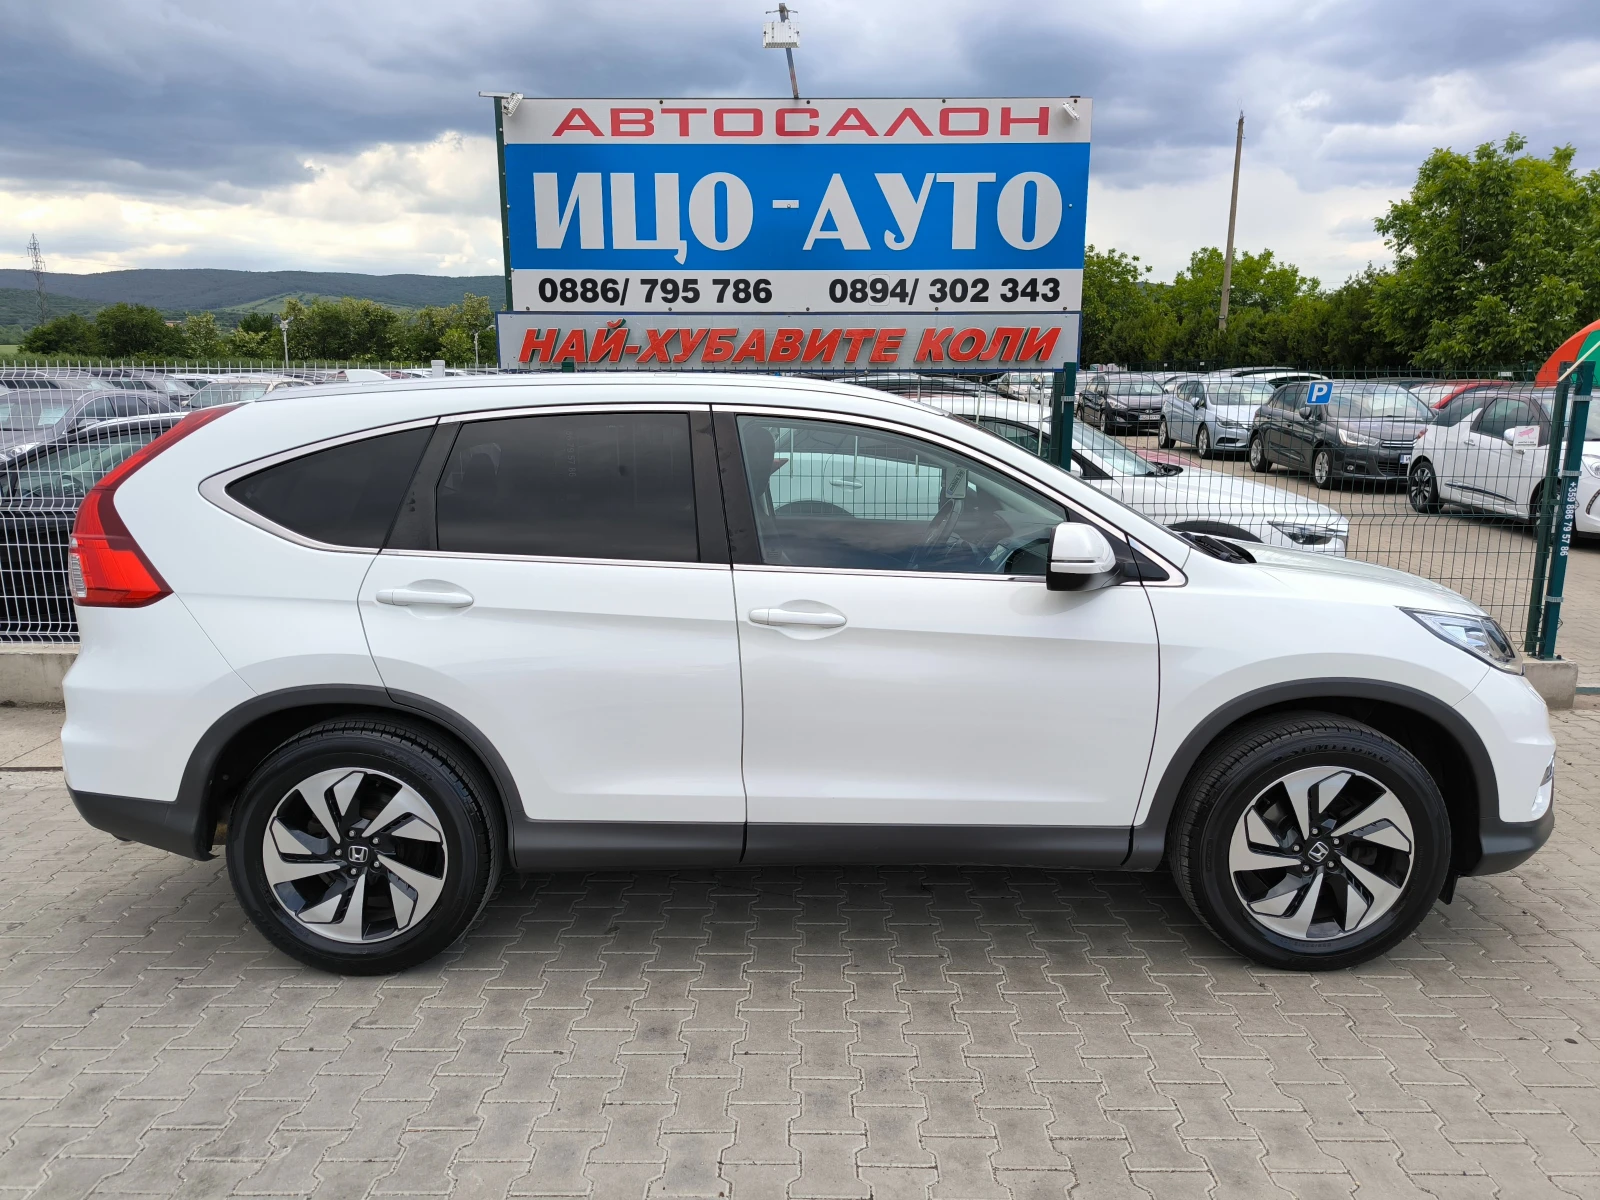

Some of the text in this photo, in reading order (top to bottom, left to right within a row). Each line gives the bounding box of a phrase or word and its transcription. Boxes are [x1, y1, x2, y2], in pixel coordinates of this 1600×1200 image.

[552, 106, 1051, 138] АВТОСАЛОН
[533, 172, 754, 265] ИЦО
[802, 171, 1063, 251] АУТО
[538, 277, 1060, 306] 0886/ 795 786 0894/ 302 343
[518, 319, 1062, 363] НАЙ-ХУБАВИТЕ КОЛИ
[1311, 384, 1328, 402] P
[1560, 482, 1576, 556] +359 886 79 57 86
